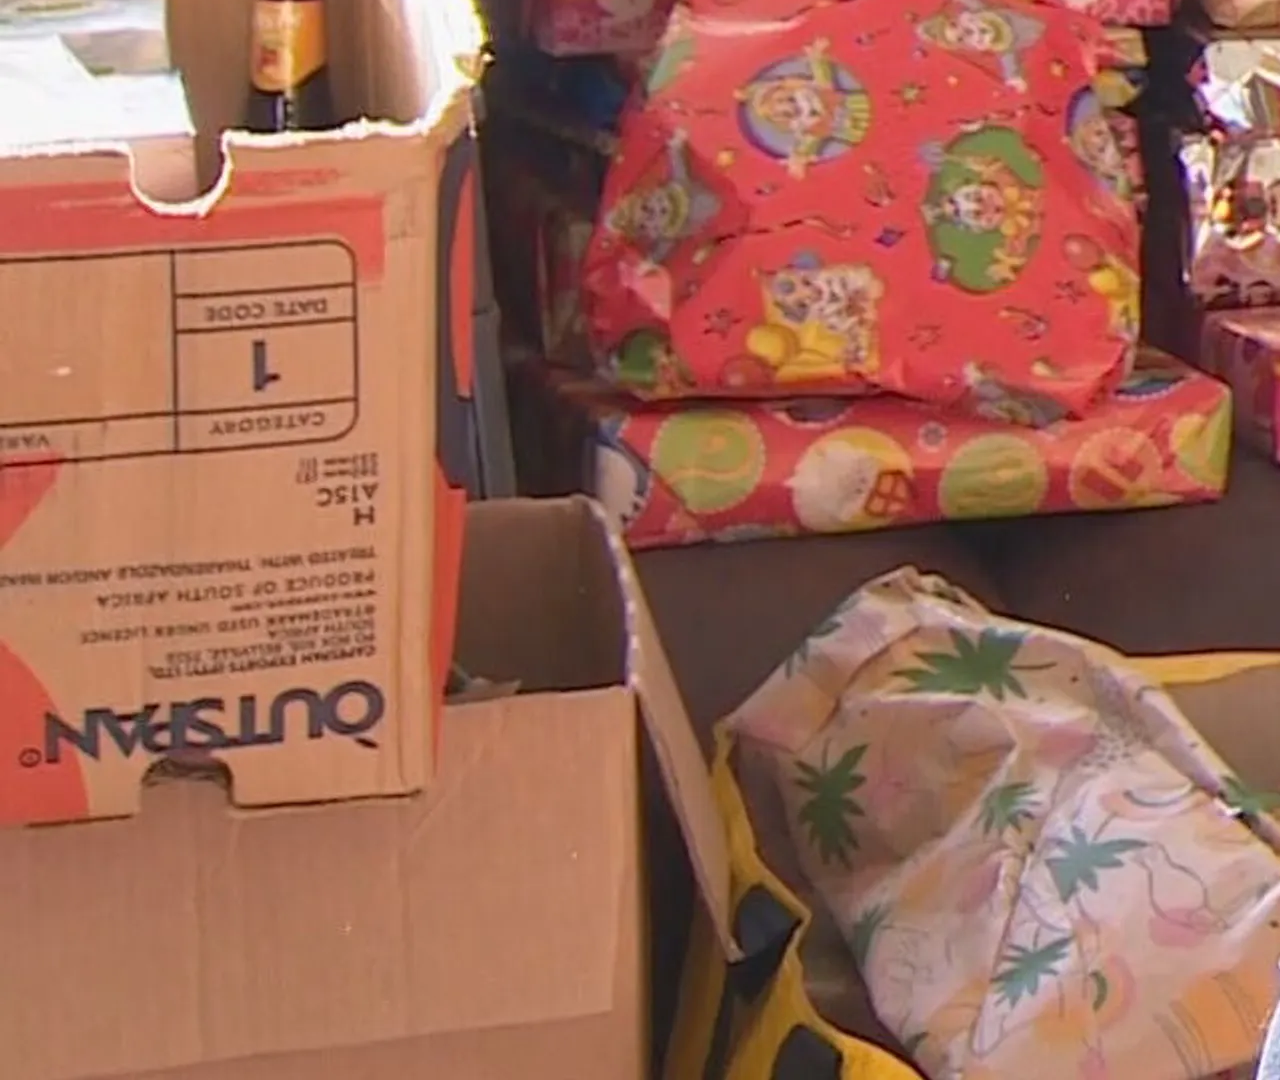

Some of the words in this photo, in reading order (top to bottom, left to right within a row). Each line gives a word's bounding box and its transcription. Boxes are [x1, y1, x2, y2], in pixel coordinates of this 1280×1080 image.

[205, 302, 265, 324] CODE
[269, 298, 328, 320] DATE
[252, 340, 281, 393] 1
[209, 412, 326, 435] CATEGORY
[316, 483, 379, 507] A15C
[354, 505, 375, 526] H
[252, 581, 278, 598] OF
[284, 568, 376, 593] PRODUCE
[97, 590, 170, 609] AFRICA
[178, 583, 245, 602] SOUTH
[81, 625, 149, 645] LICENCE
[155, 622, 210, 638] UNDER
[217, 617, 260, 634] USED
[43, 679, 386, 764] OUTSPAN
